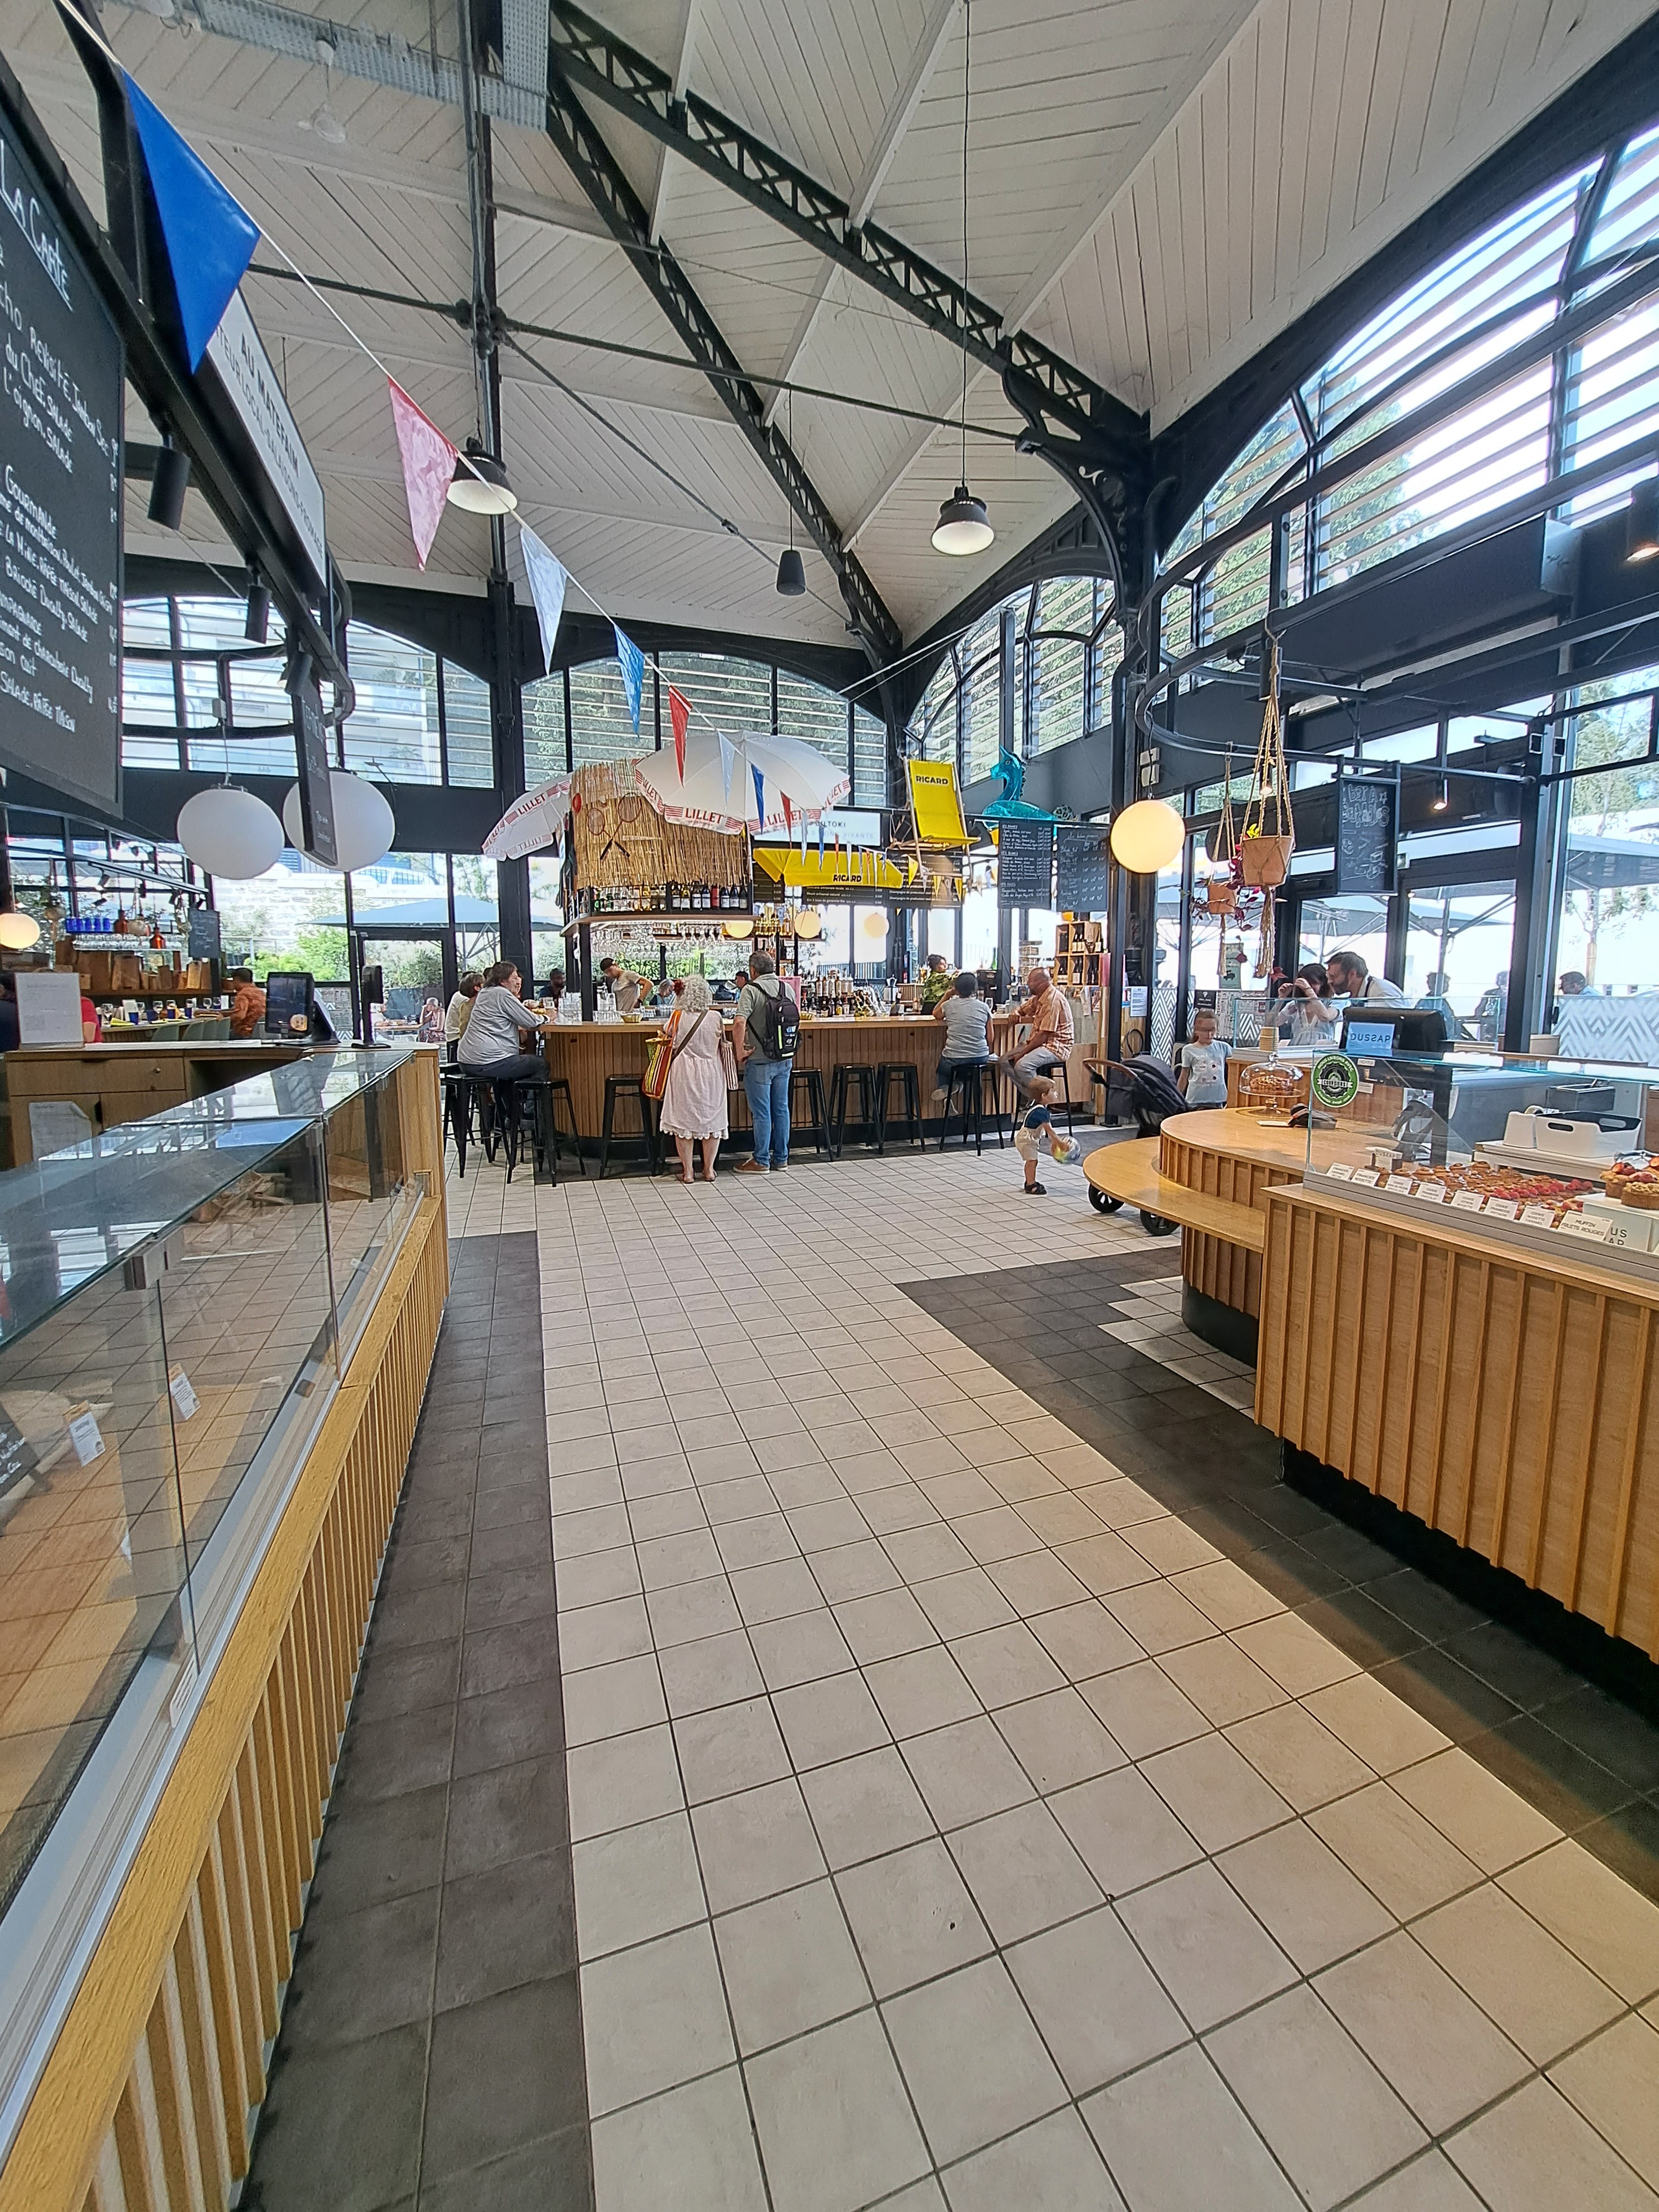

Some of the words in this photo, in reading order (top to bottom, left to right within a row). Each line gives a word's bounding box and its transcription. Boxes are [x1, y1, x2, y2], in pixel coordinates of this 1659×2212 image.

[241, 333, 254, 378] AU
[916, 775, 948, 784] RICARD
[517, 792, 545, 815] LILLET
[685, 807, 724, 824] LILLET
[767, 810, 802, 826] LILET
[1350, 1033, 1390, 1042] DUSSAP
[1581, 1227, 1604, 1236] ROUGES
[1610, 1227, 1627, 1238] US
